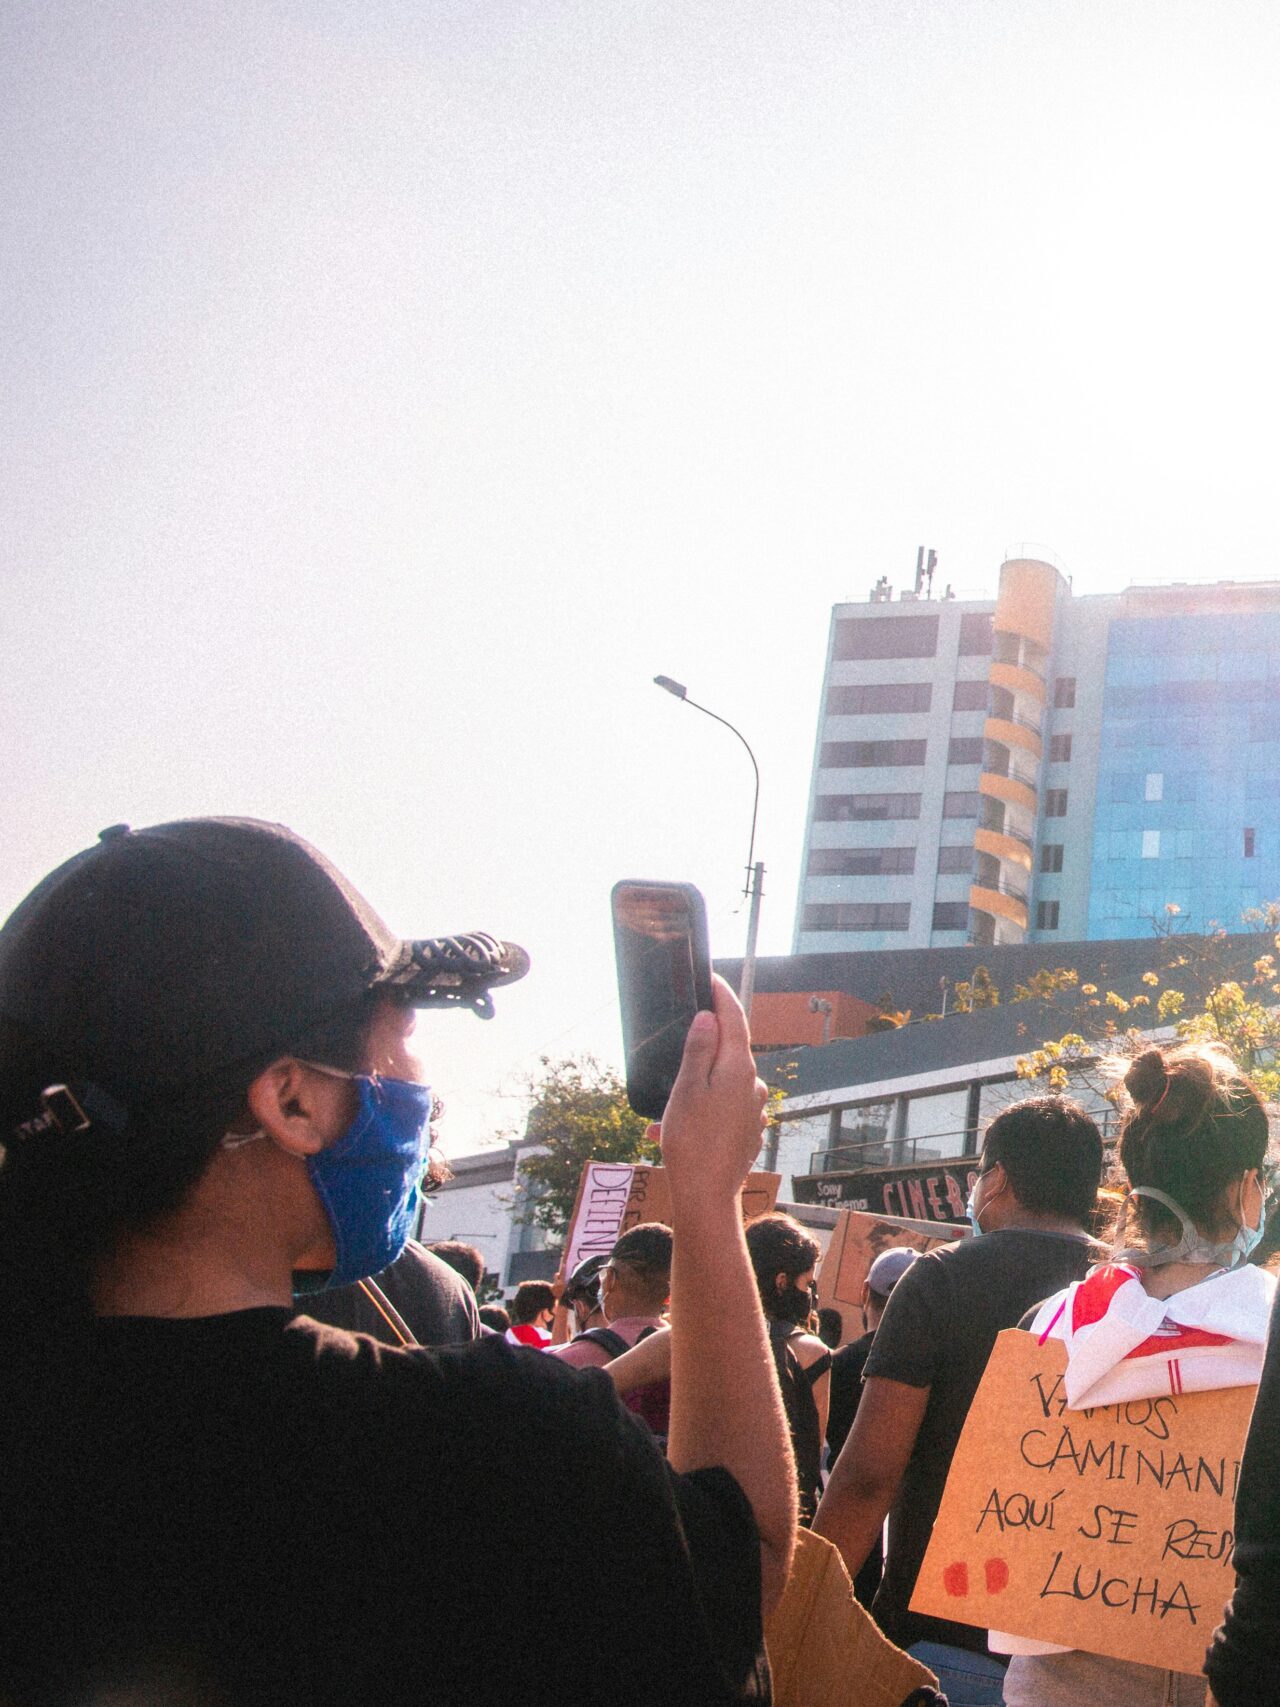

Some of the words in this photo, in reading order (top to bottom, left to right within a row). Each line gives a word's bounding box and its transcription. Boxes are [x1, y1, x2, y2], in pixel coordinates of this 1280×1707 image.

[573, 1167, 633, 1270] DEFIEND
[817, 1182, 842, 1198] Sony
[1029, 1373, 1179, 1440] VOS
[1019, 1426, 1241, 1501] CAMINAN
[975, 1488, 1066, 1534] AQUÍ
[1078, 1504, 1138, 1545] SE
[1039, 1551, 1201, 1625] LUCHA
